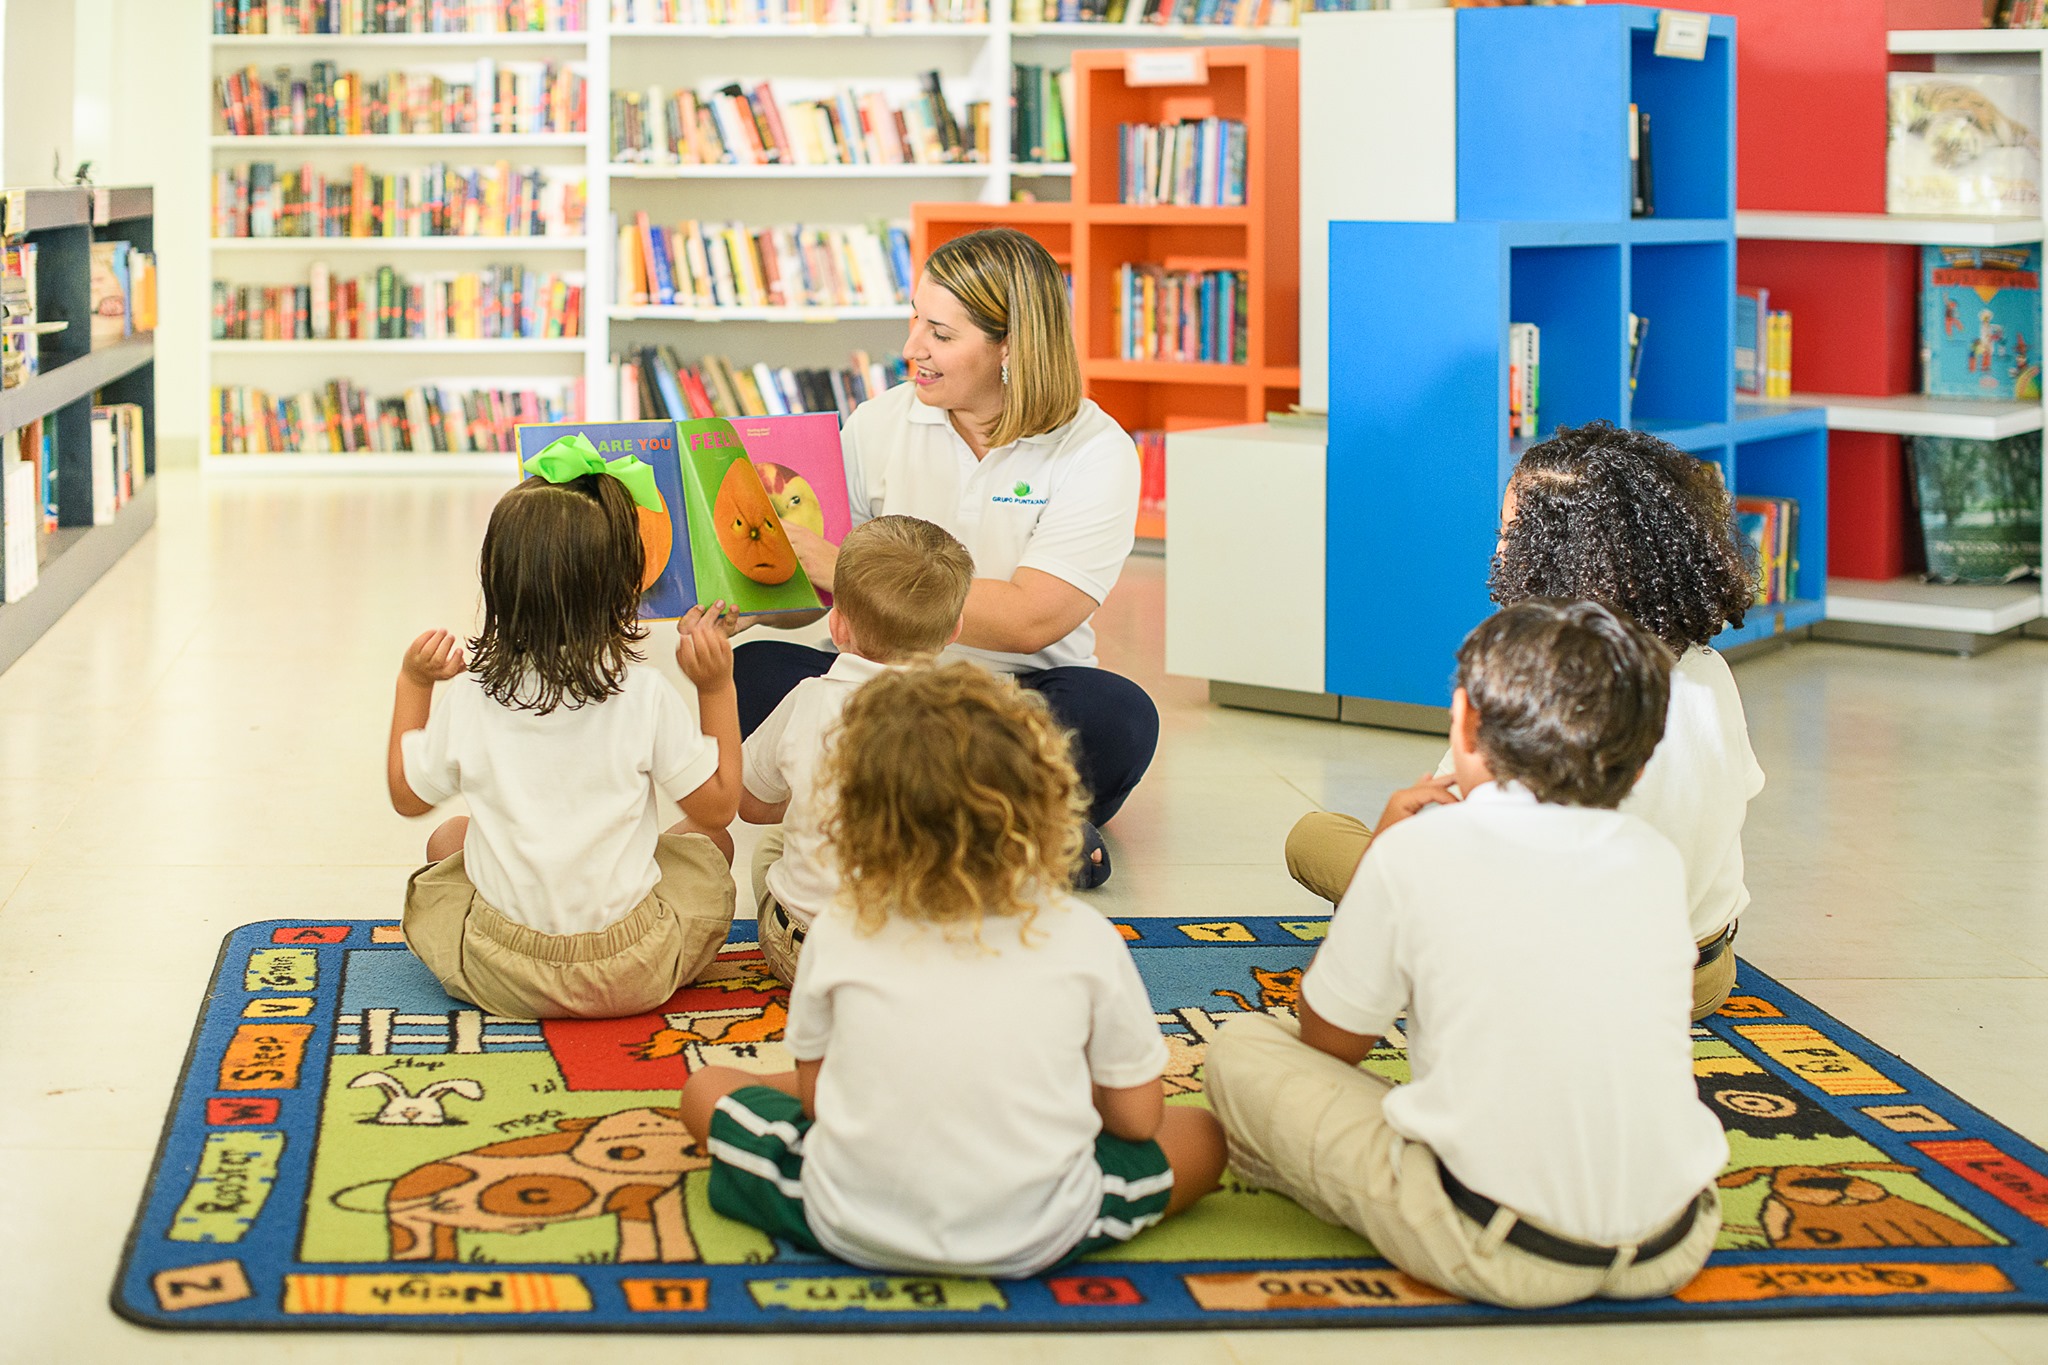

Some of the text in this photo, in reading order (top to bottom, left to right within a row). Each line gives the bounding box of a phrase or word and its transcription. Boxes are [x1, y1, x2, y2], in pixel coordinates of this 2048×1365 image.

[597, 440, 633, 453] ARE
[637, 438, 672, 451] YOU
[1200, 926, 1234, 937] Y
[259, 956, 296, 986] Grain
[261, 1003, 299, 1013] V
[231, 1036, 286, 1081] Sheep
[384, 1057, 446, 1071] Hop
[1781, 1047, 1851, 1074] Pig
[195, 1149, 252, 1213] Rooster
[517, 1188, 550, 1204] C
[370, 1273, 504, 1304] Neigh
[1740, 1265, 1930, 1291] Quack
[804, 1280, 947, 1306] Barn
